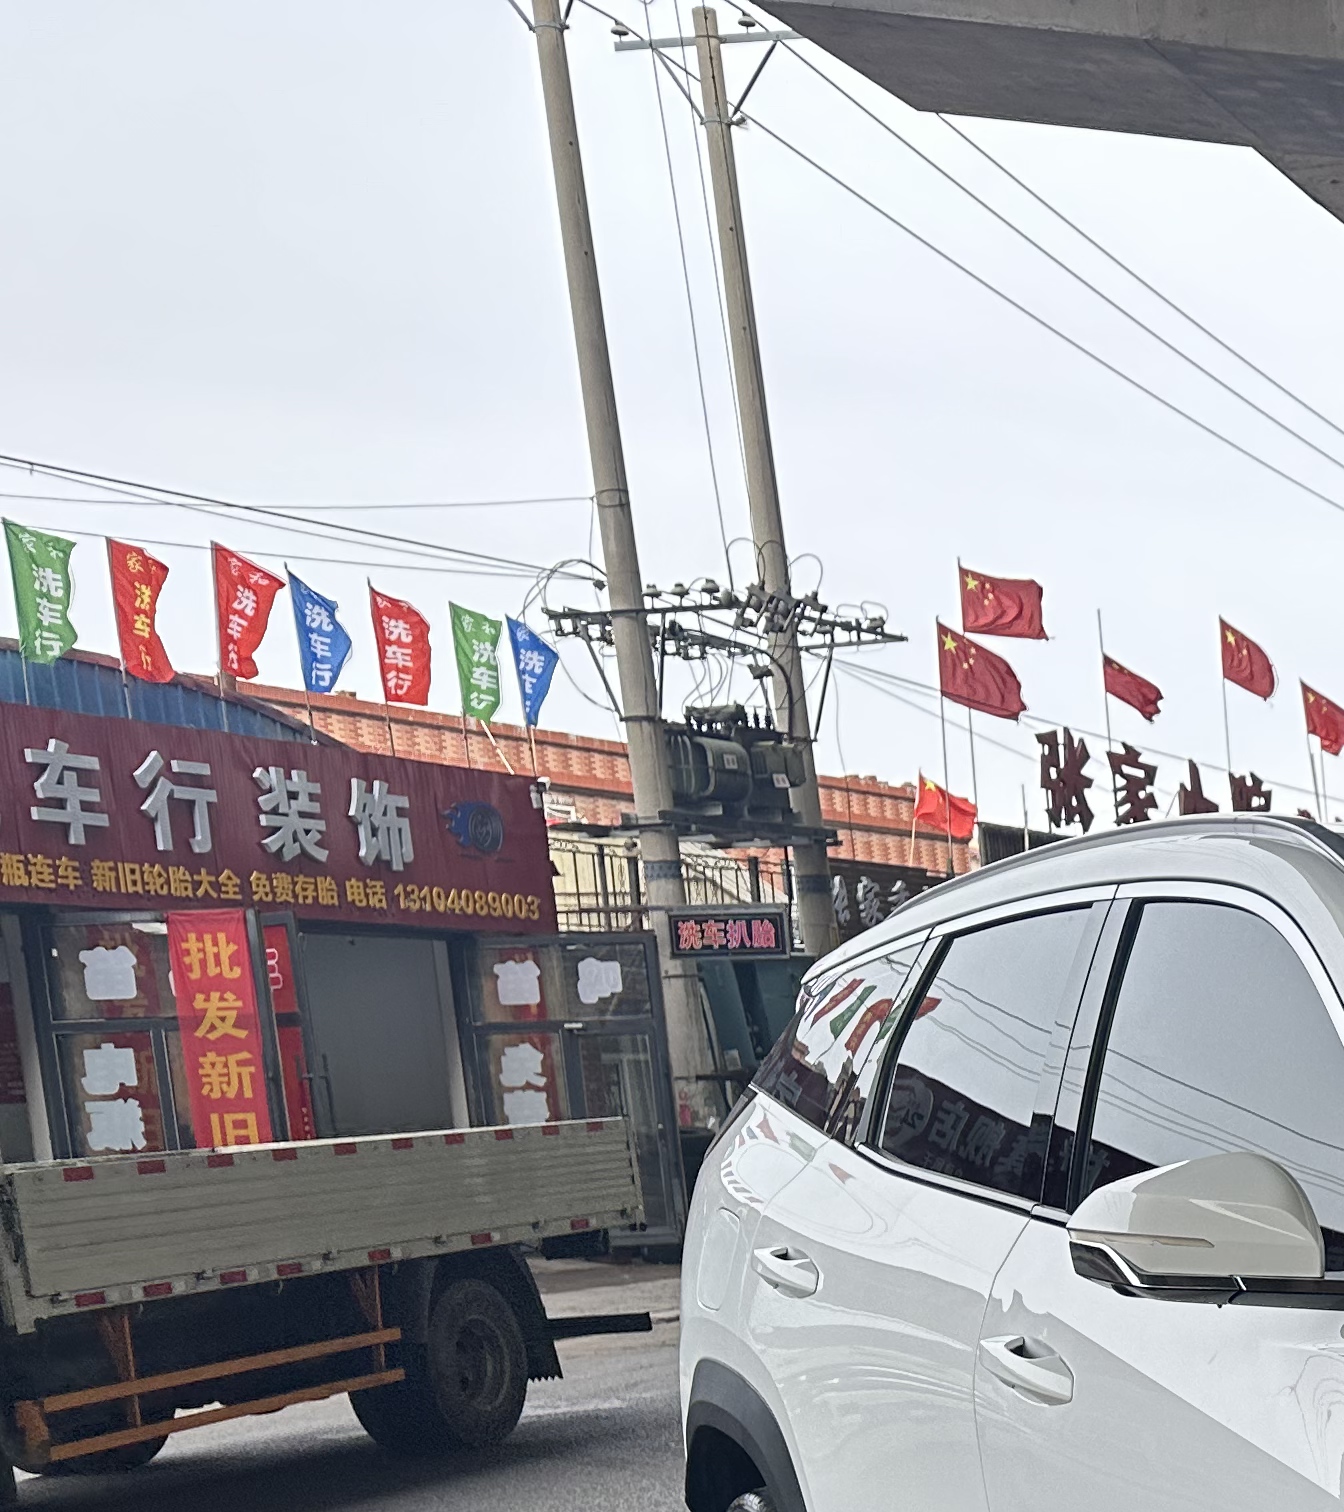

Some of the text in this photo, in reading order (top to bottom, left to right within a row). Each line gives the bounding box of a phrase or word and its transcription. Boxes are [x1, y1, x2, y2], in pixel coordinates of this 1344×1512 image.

[33, 566, 65, 656] 洗车行
[227, 584, 258, 670] 洗车行
[304, 601, 334, 687] 洗车行
[382, 615, 413, 696] 洗车行
[470, 638, 498, 710] 洗车行
[518, 648, 545, 713] 洗车
[24, 737, 415, 872] 车行装饰
[91, 858, 243, 900] 新旧轮胎大全
[250, 870, 338, 906] 免费存胎
[345, 877, 387, 909] 电话
[394, 882, 541, 921] 13104089003
[677, 918, 776, 949] 洗车扒胎
[181, 931, 260, 1145] 批发新旧
